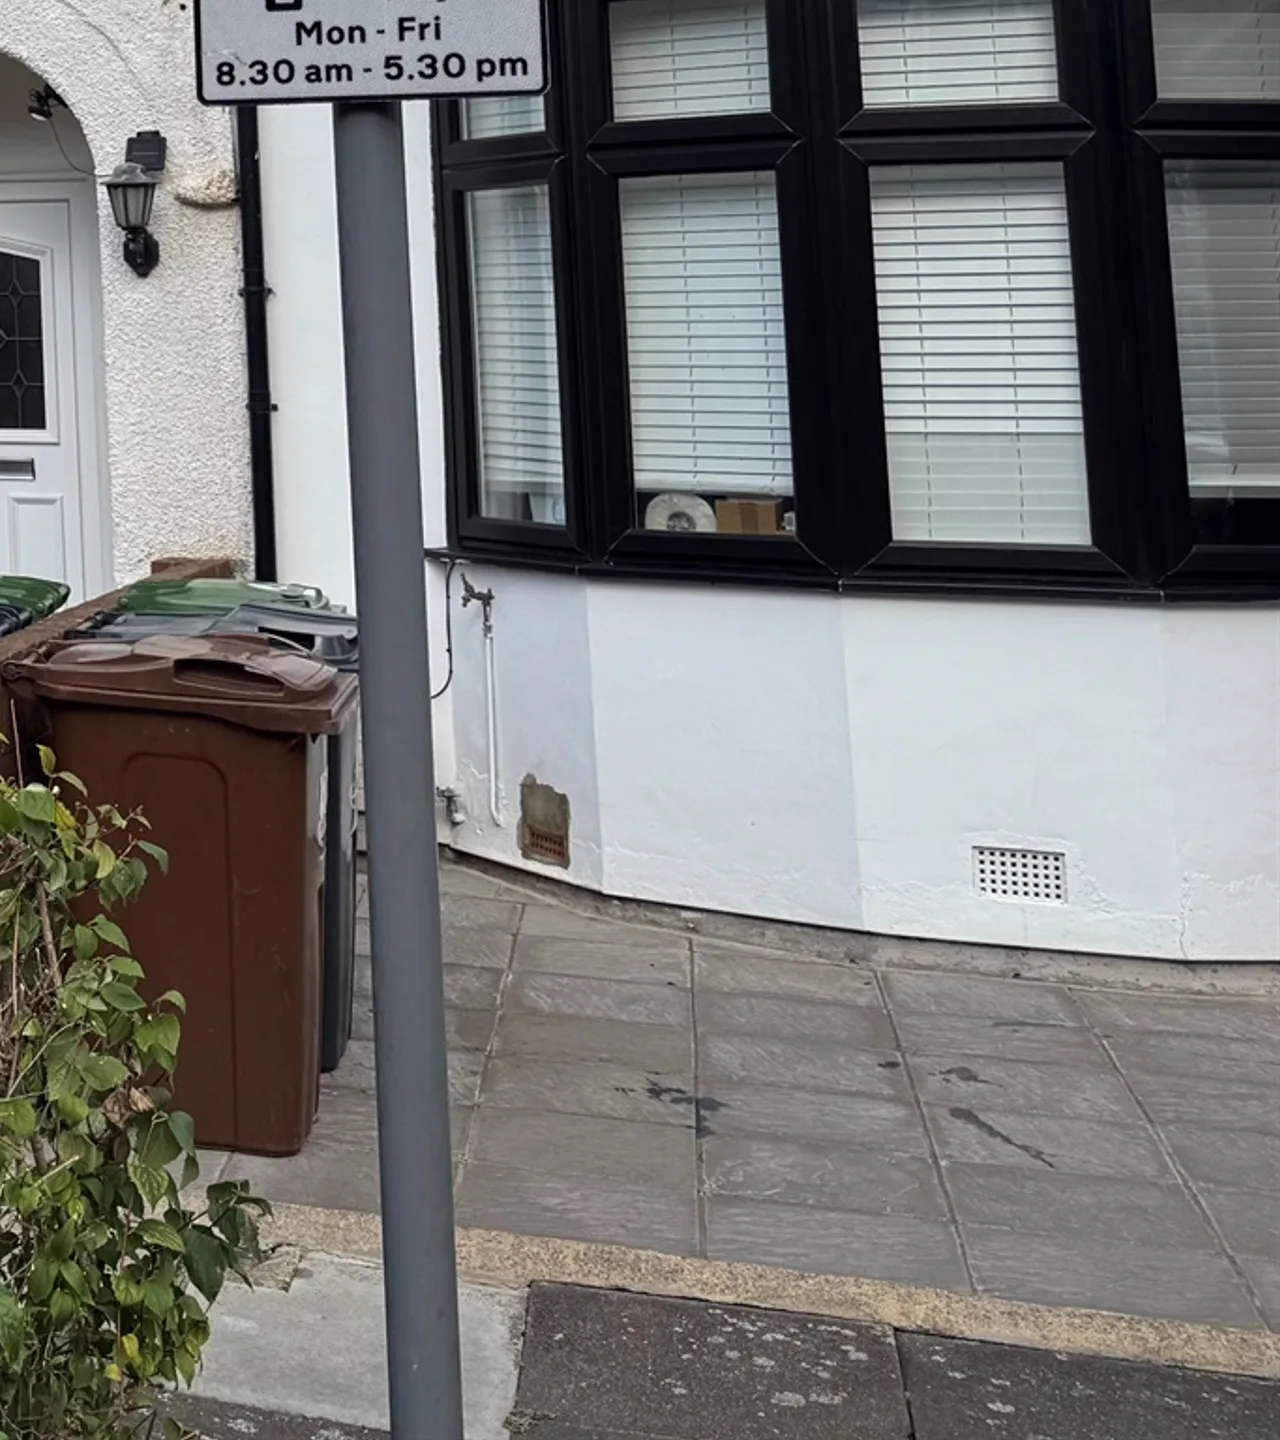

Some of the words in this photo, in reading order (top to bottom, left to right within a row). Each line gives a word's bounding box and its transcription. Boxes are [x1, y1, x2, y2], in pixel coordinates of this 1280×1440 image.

[295, 21, 366, 46] Mon
[398, 16, 442, 42] Fri
[216, 59, 295, 86] 8.30
[304, 64, 353, 84] am
[383, 53, 466, 82] 5.30
[476, 57, 528, 83] pm
